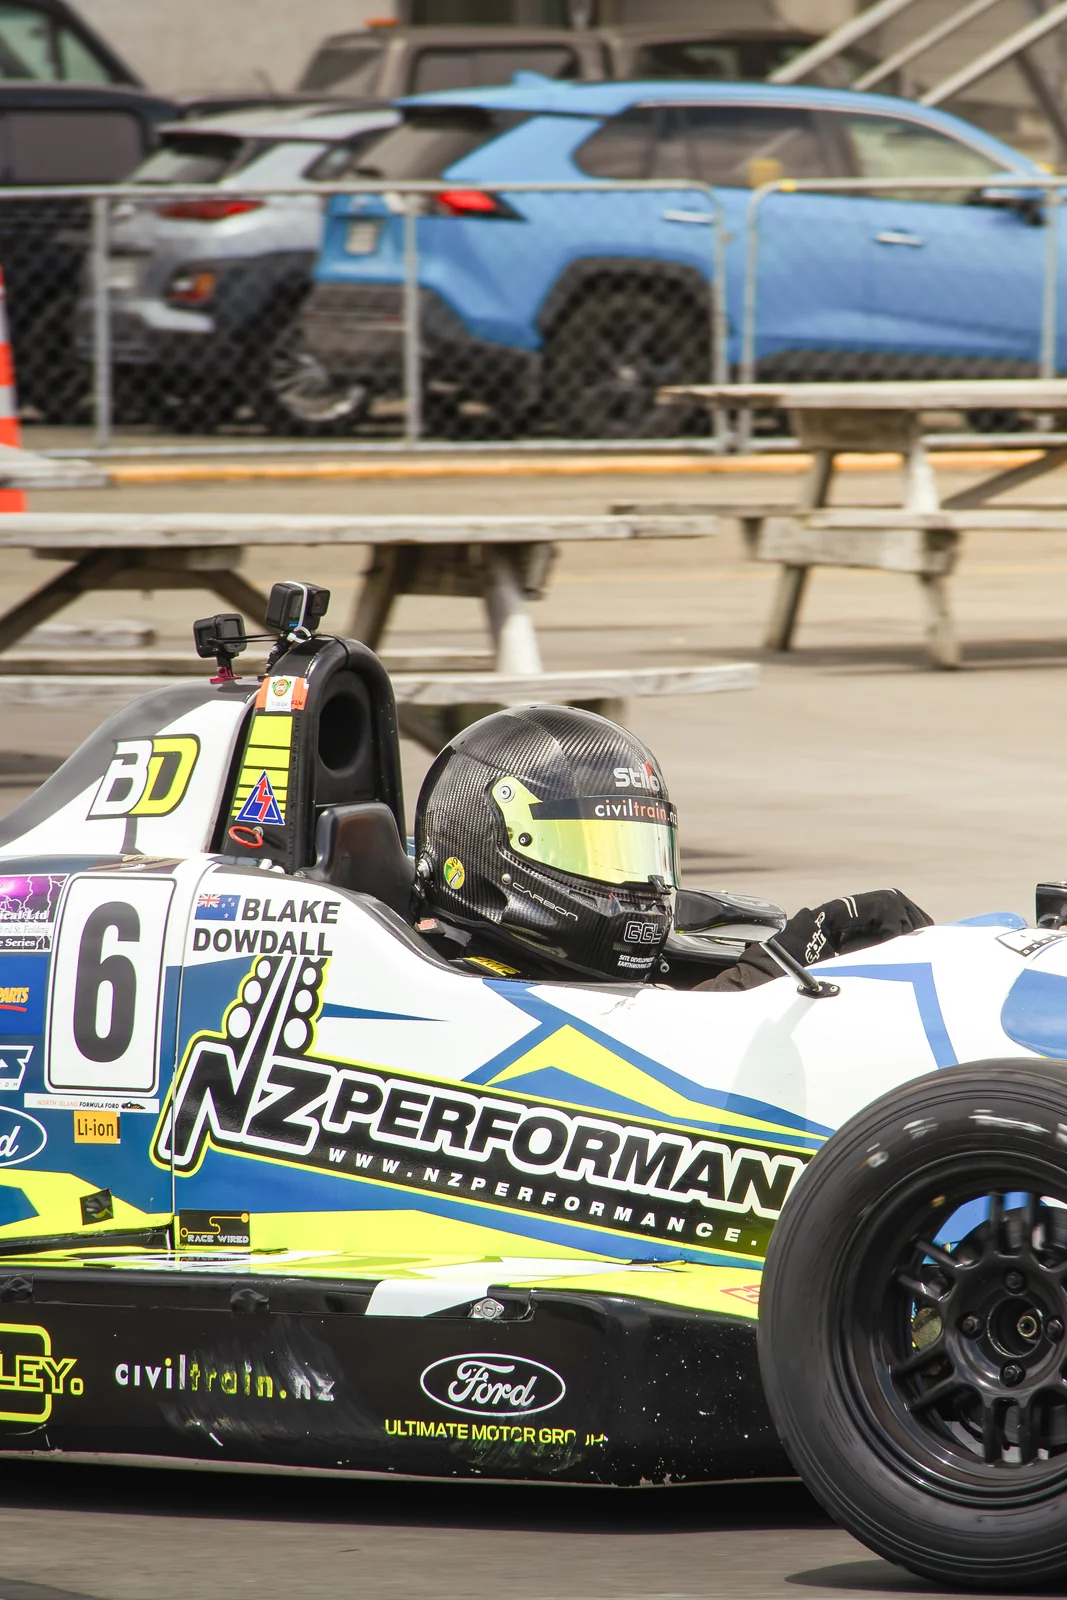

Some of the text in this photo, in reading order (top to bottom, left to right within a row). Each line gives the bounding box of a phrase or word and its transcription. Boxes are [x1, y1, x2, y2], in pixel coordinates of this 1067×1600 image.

[86, 734, 200, 820] BD
[613, 761, 660, 792] Stilo
[241, 898, 341, 924] BLAKE
[5, 938, 36, 947] Series
[192, 927, 333, 957] DOWDALL
[73, 901, 140, 1062] 6
[37, 1099, 57, 1107] NORTH
[79, 1101, 104, 1109] FORMULA
[77, 1118, 114, 1137] Li-ion
[155, 1036, 804, 1220] NZPERFORMAN
[188, 1235, 249, 1244] RACE WIRED
[448, 1360, 537, 1407] Ford
[385, 1419, 468, 1440] ULTIMATE
[472, 1424, 536, 1443] MOTOR
